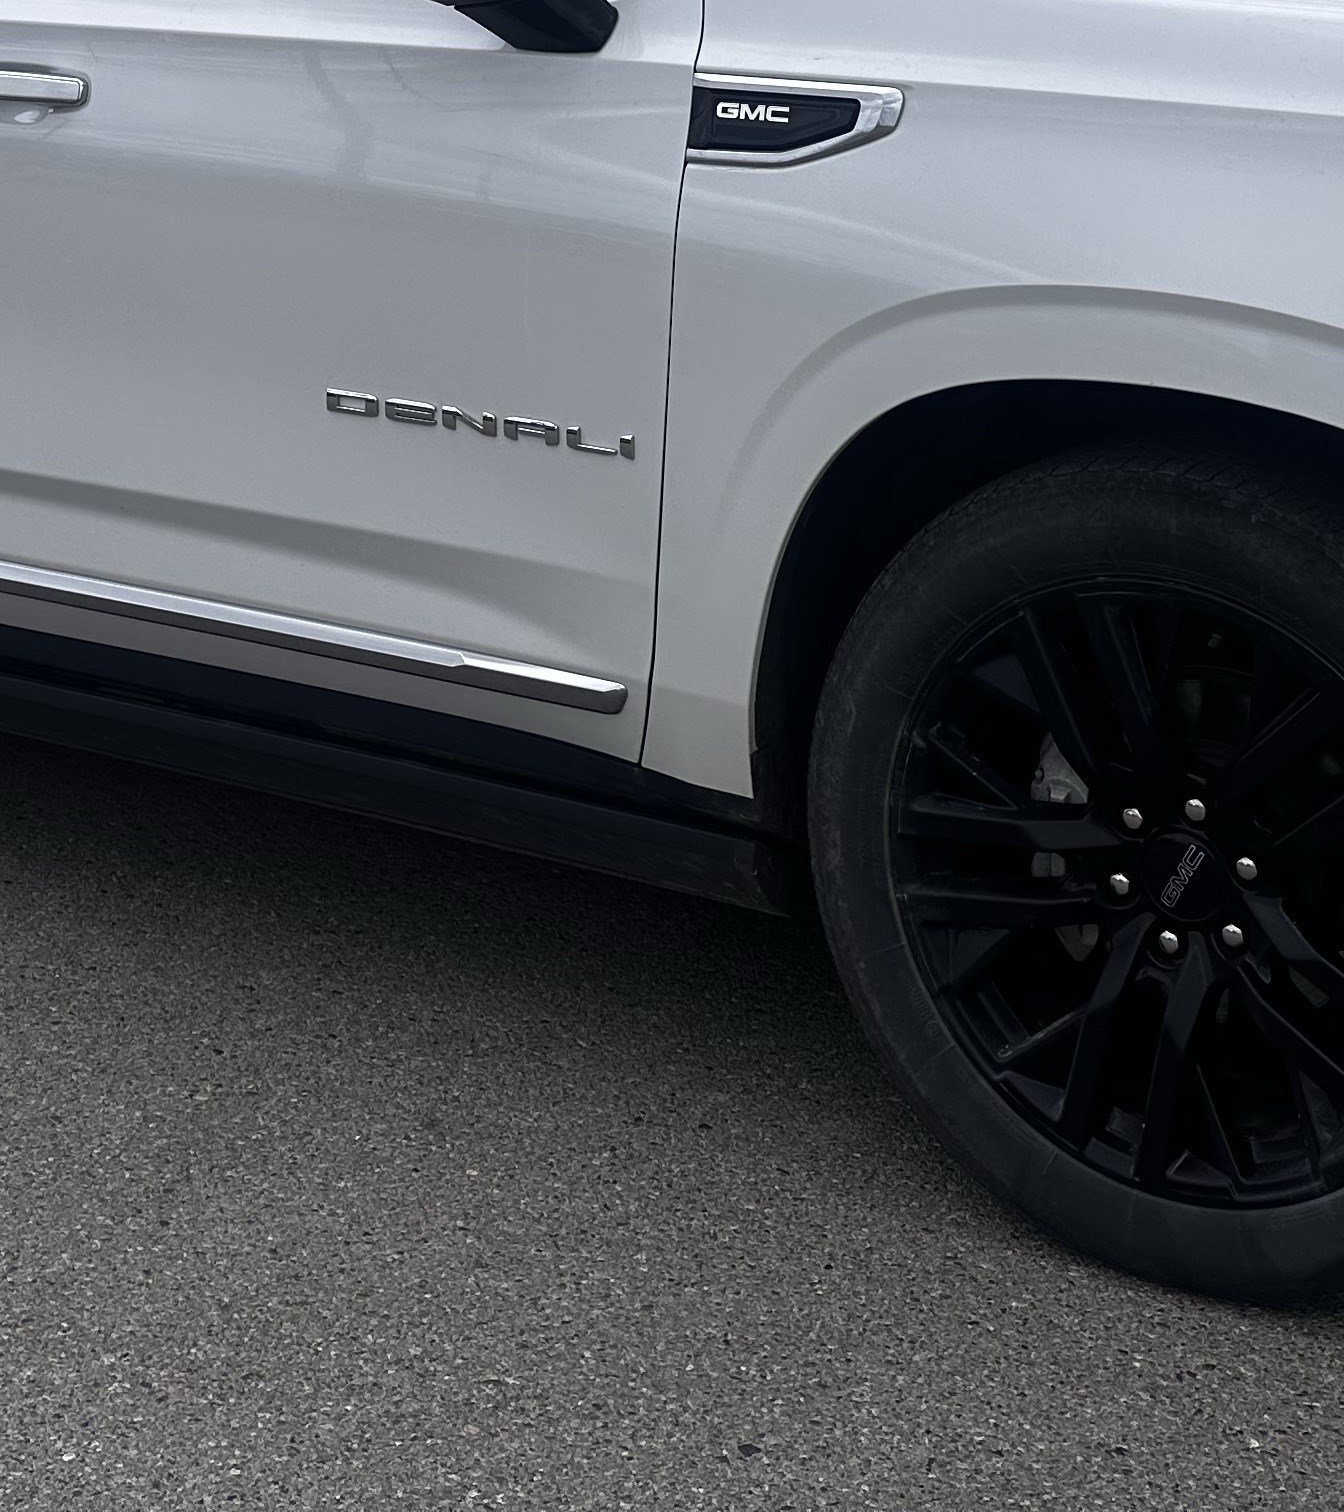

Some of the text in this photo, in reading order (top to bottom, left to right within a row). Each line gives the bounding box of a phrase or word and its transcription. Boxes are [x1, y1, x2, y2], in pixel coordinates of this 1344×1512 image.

[716, 101, 790, 123] GMC
[326, 387, 635, 460] DENALI
[1160, 844, 1205, 908] GMC
